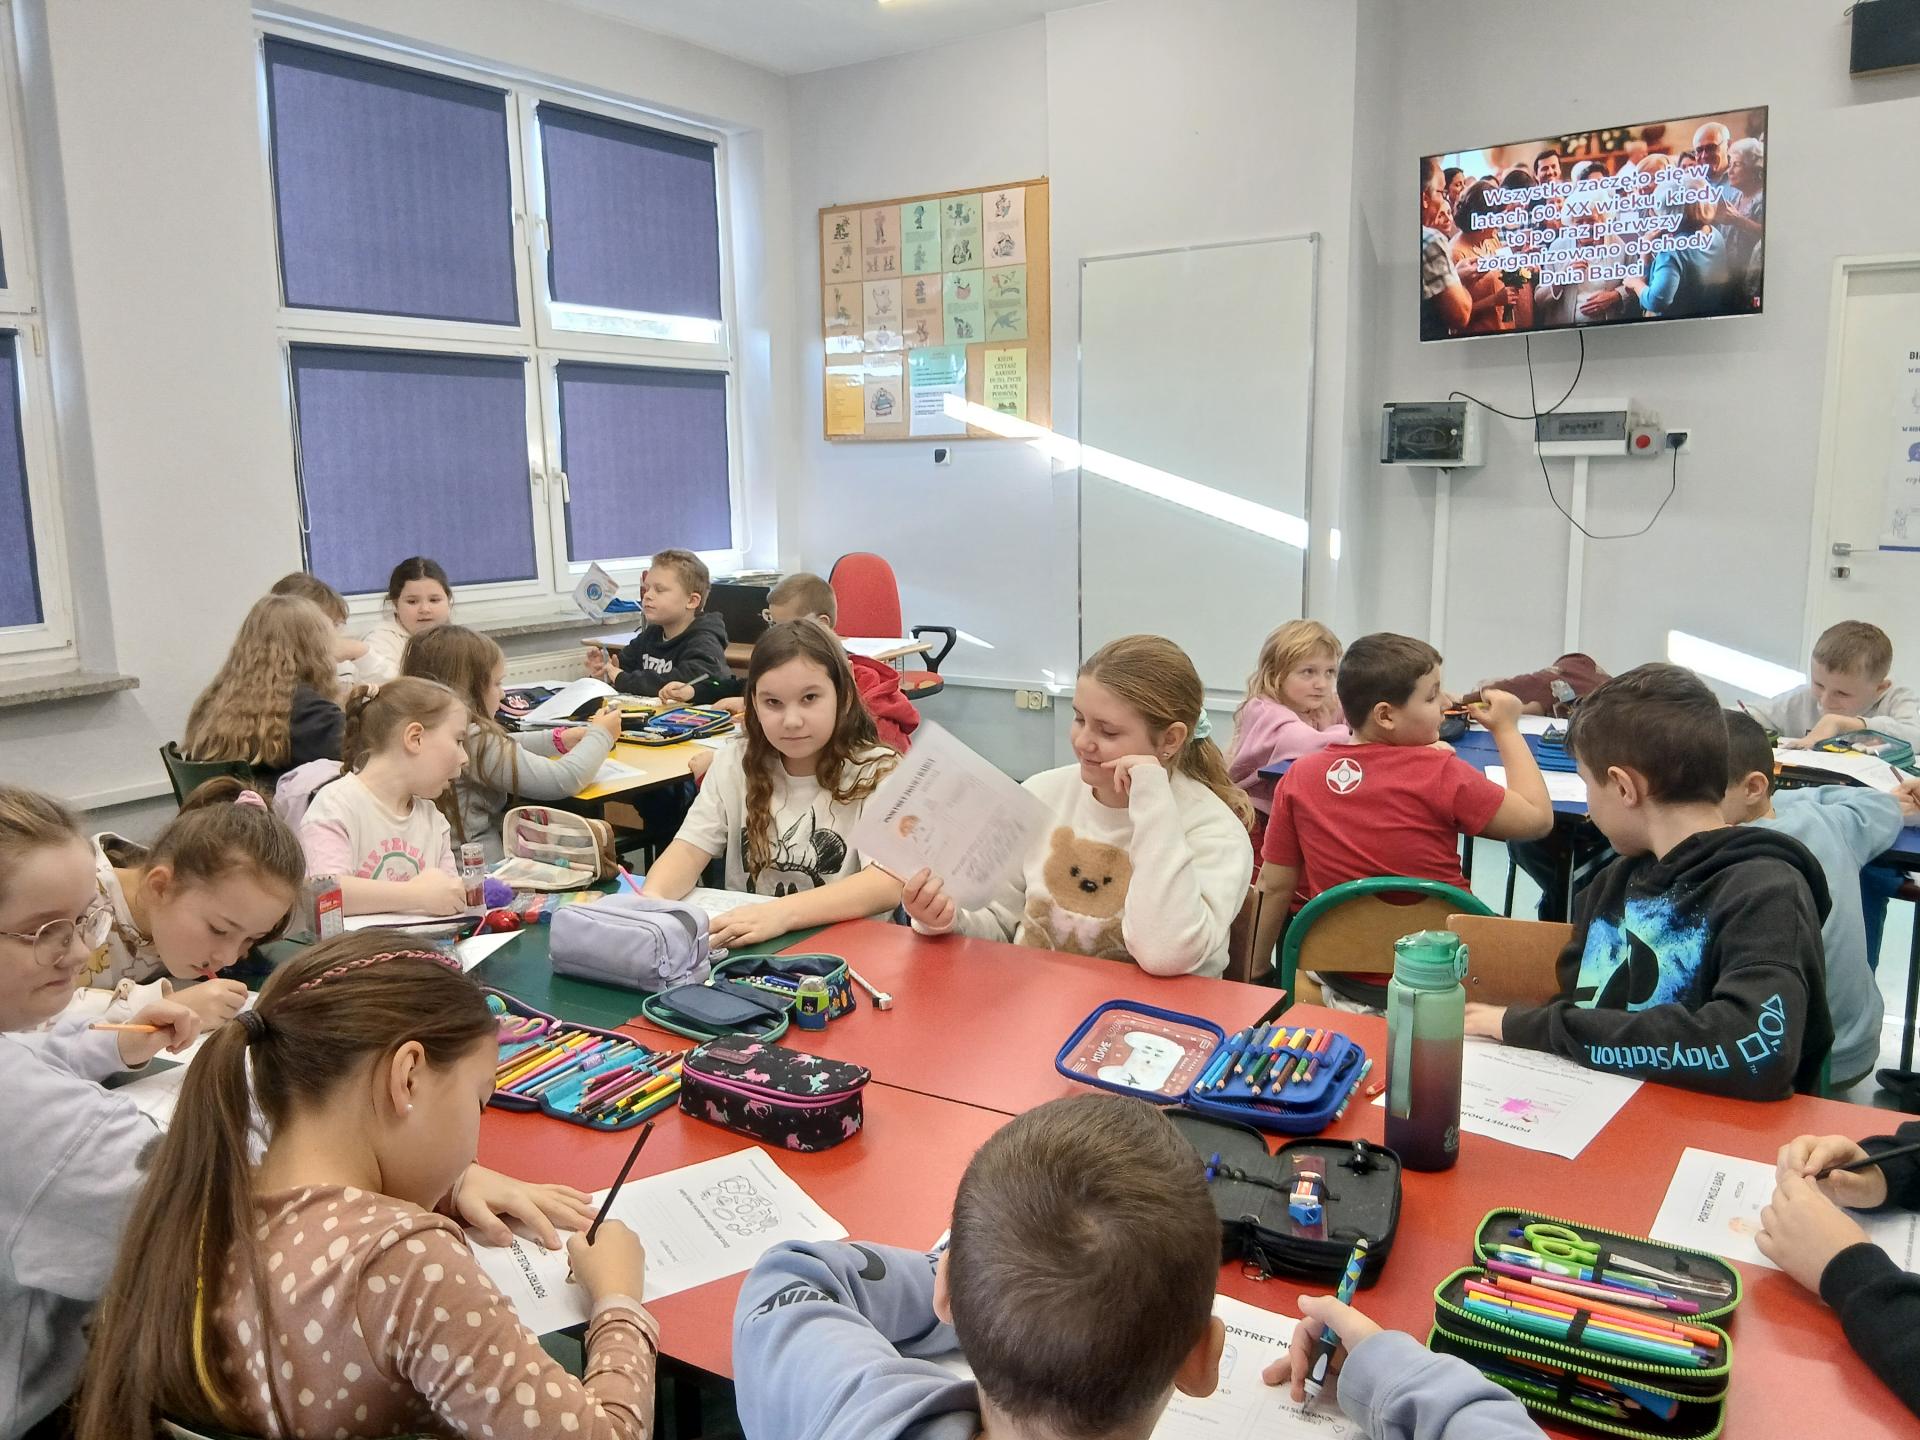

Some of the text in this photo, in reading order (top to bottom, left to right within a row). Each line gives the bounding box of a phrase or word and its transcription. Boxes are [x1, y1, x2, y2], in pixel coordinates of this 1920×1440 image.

[1484, 165, 1708, 206] Wszystko zaczęło się w
[1472, 185, 1722, 229] latach 60. XX wieku, kiedy
[1506, 214, 1682, 247] to po raz pierwszy
[1478, 232, 1712, 272] zorganizowano obchody
[1540, 260, 1644, 285] Dnia Babci
[1225, 1324, 1274, 1345] ORTRET
